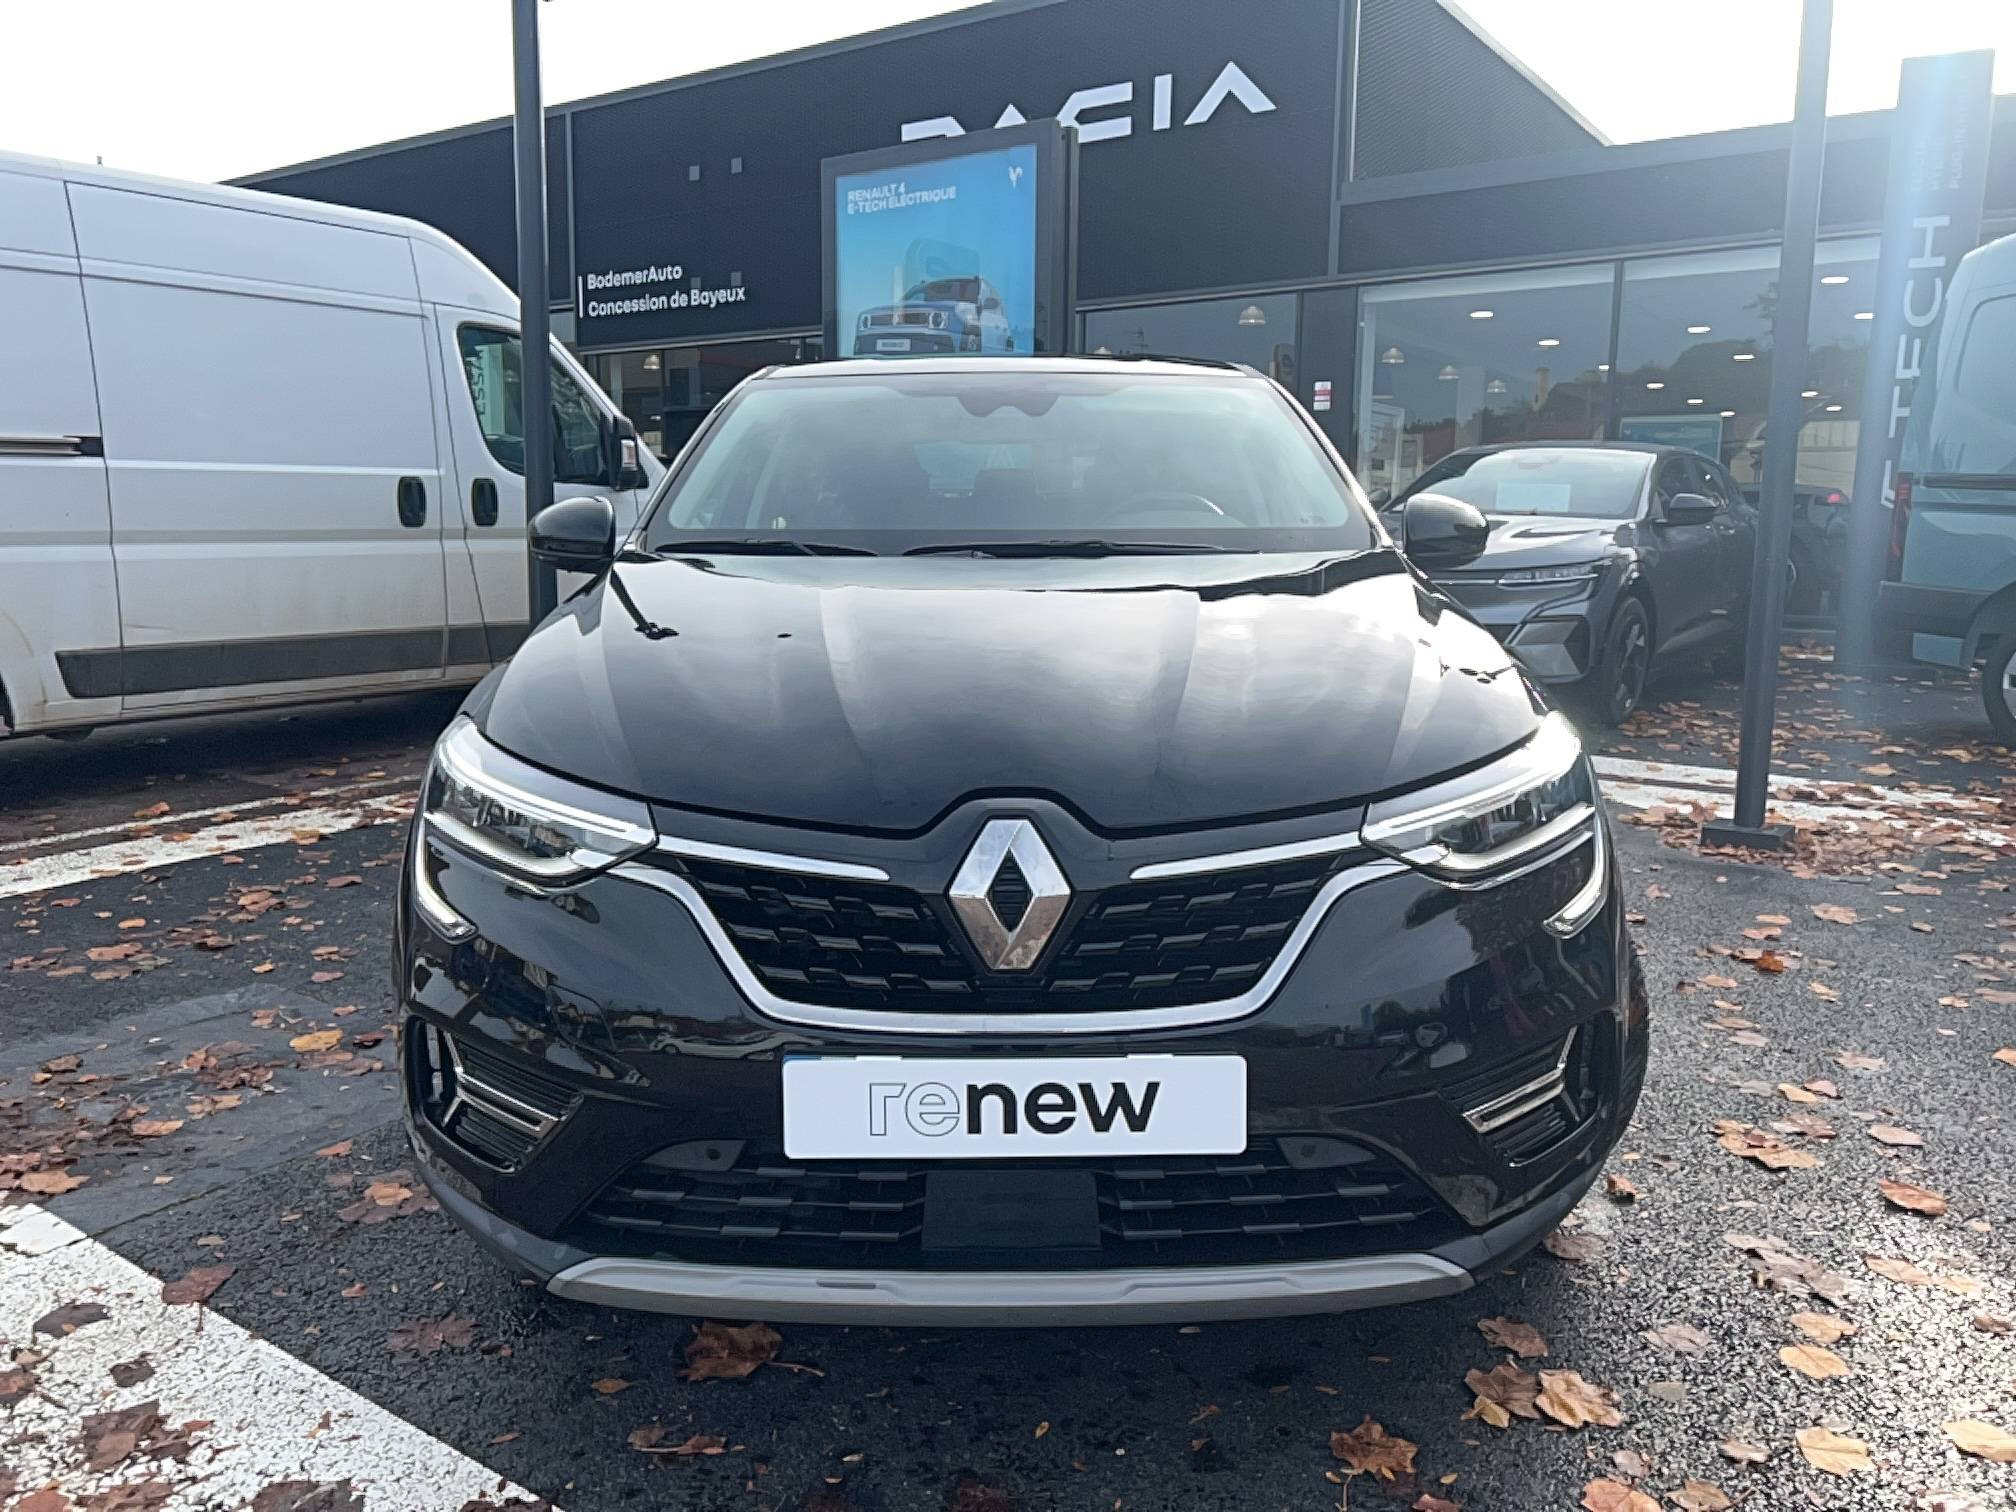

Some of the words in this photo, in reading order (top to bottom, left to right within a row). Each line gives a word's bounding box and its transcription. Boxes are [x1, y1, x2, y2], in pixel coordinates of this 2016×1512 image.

[901, 61, 1278, 143] CIA
[847, 183, 898, 202] RENAULT
[898, 182, 906, 195] 4
[847, 199, 886, 215] E-TECH
[587, 265, 682, 290] BodemerAuto
[588, 294, 667, 317] Concession
[670, 290, 689, 308] de
[690, 286, 746, 309] Bayeux
[1881, 215, 1950, 508] TECH
[869, 1081, 1161, 1137] renew
